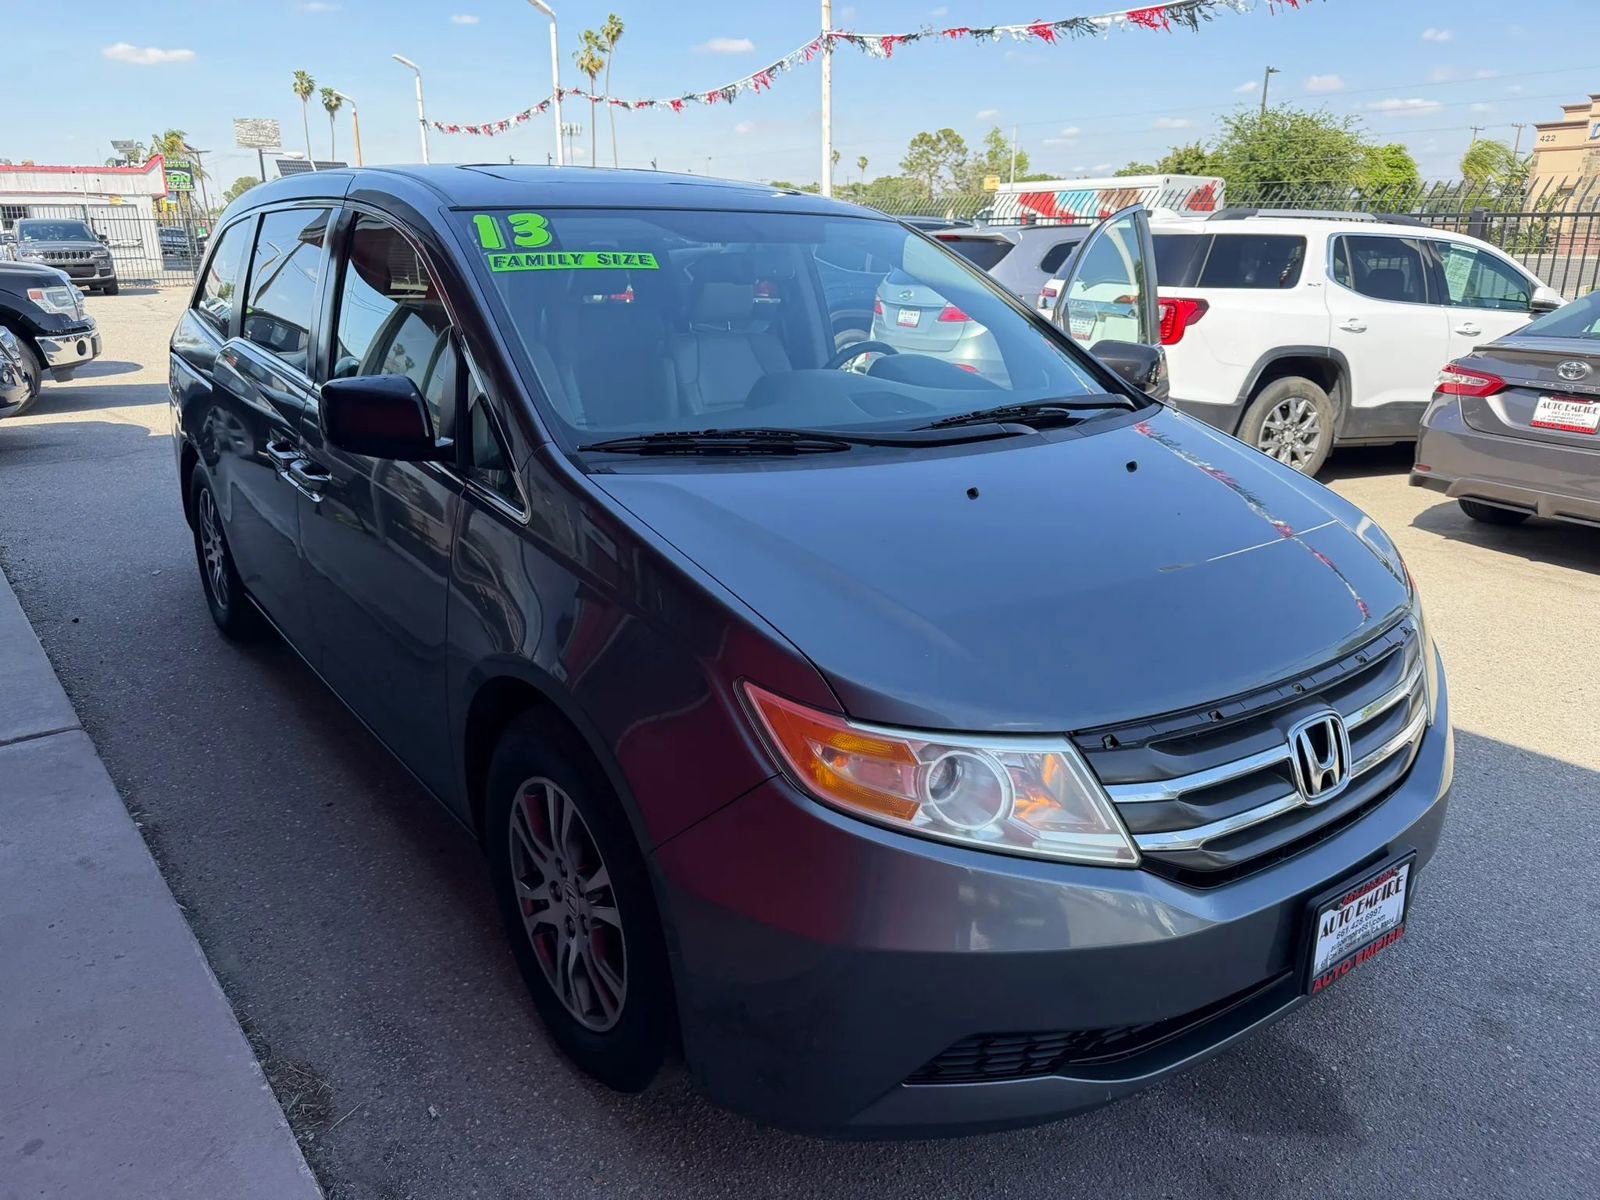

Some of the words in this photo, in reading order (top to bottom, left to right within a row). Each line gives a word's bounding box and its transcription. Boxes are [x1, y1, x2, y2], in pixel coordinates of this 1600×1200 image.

[473, 212, 552, 250] 13
[493, 253, 583, 268] FAMILY
[597, 253, 651, 266] SIZE
[1541, 402, 1564, 412] AUTO
[1320, 905, 1355, 938] AUTO
[1355, 875, 1404, 917] EMPIRE
[1312, 959, 1353, 994] AUTO
[1354, 927, 1406, 968] EMPIRE
